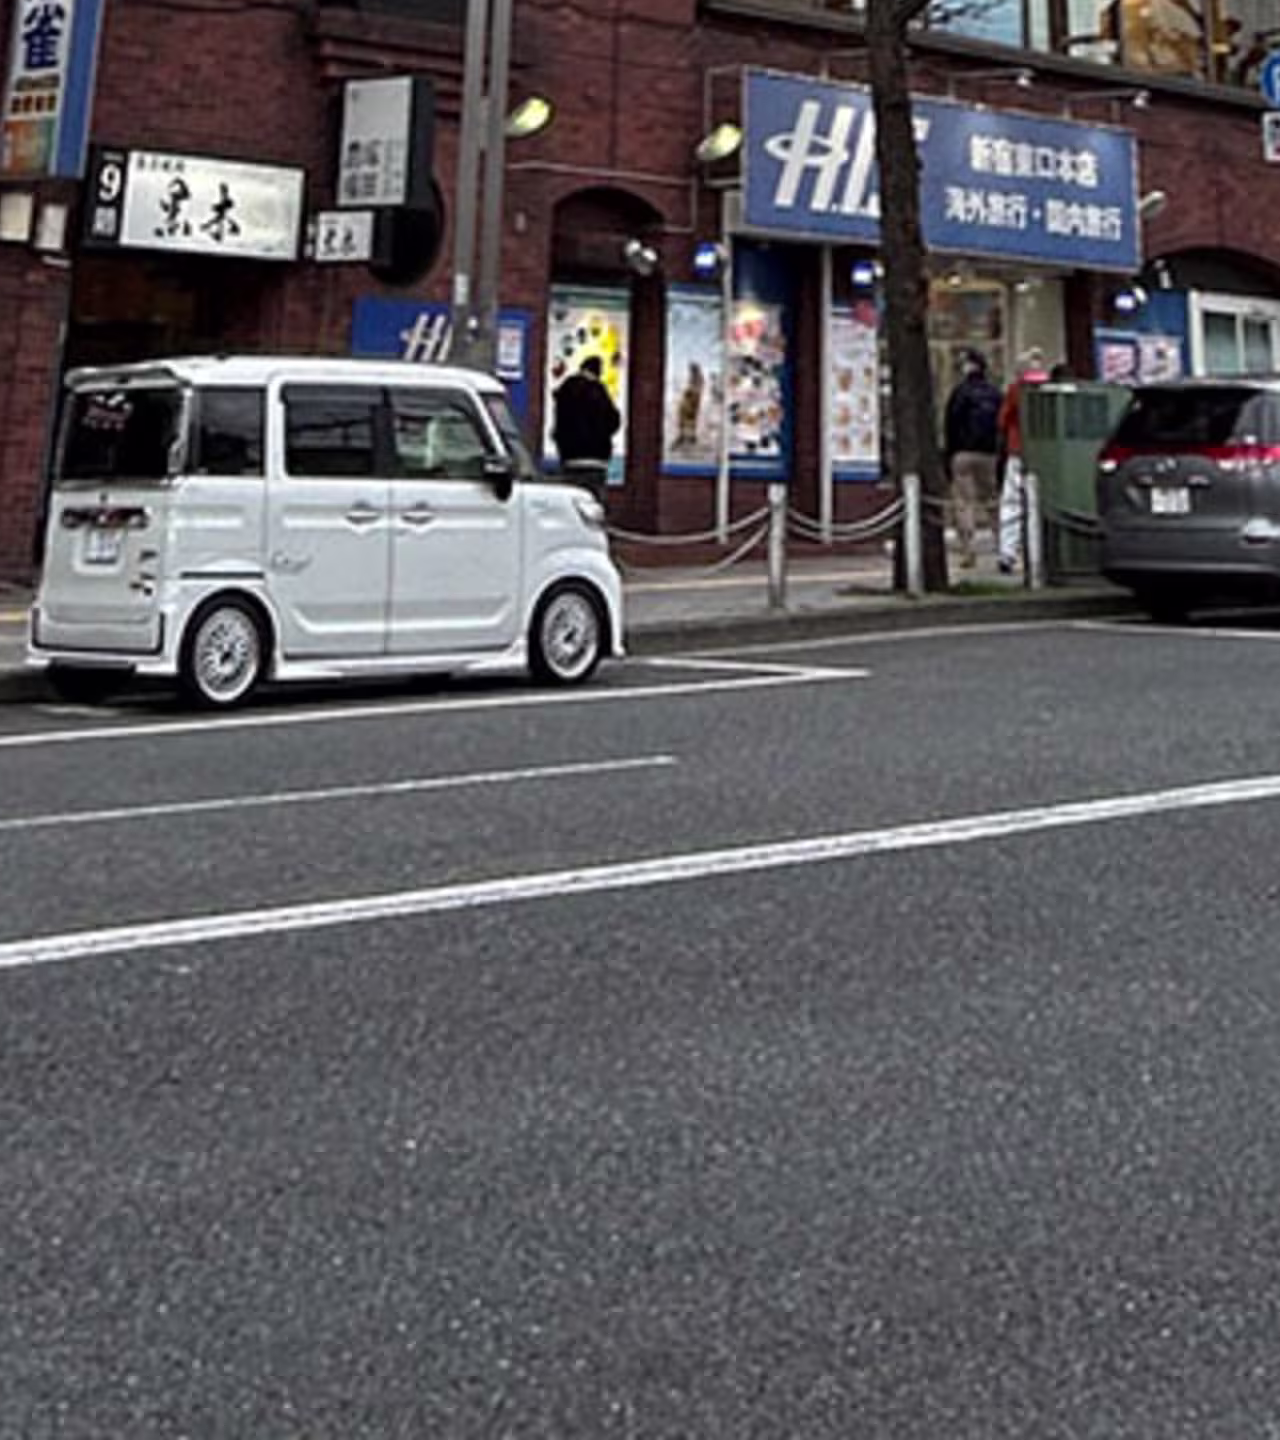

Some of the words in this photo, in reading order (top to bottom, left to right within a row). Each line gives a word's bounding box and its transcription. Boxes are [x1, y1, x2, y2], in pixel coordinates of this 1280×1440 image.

[944, 186, 1123, 242] 海外旅行・国内旅行
